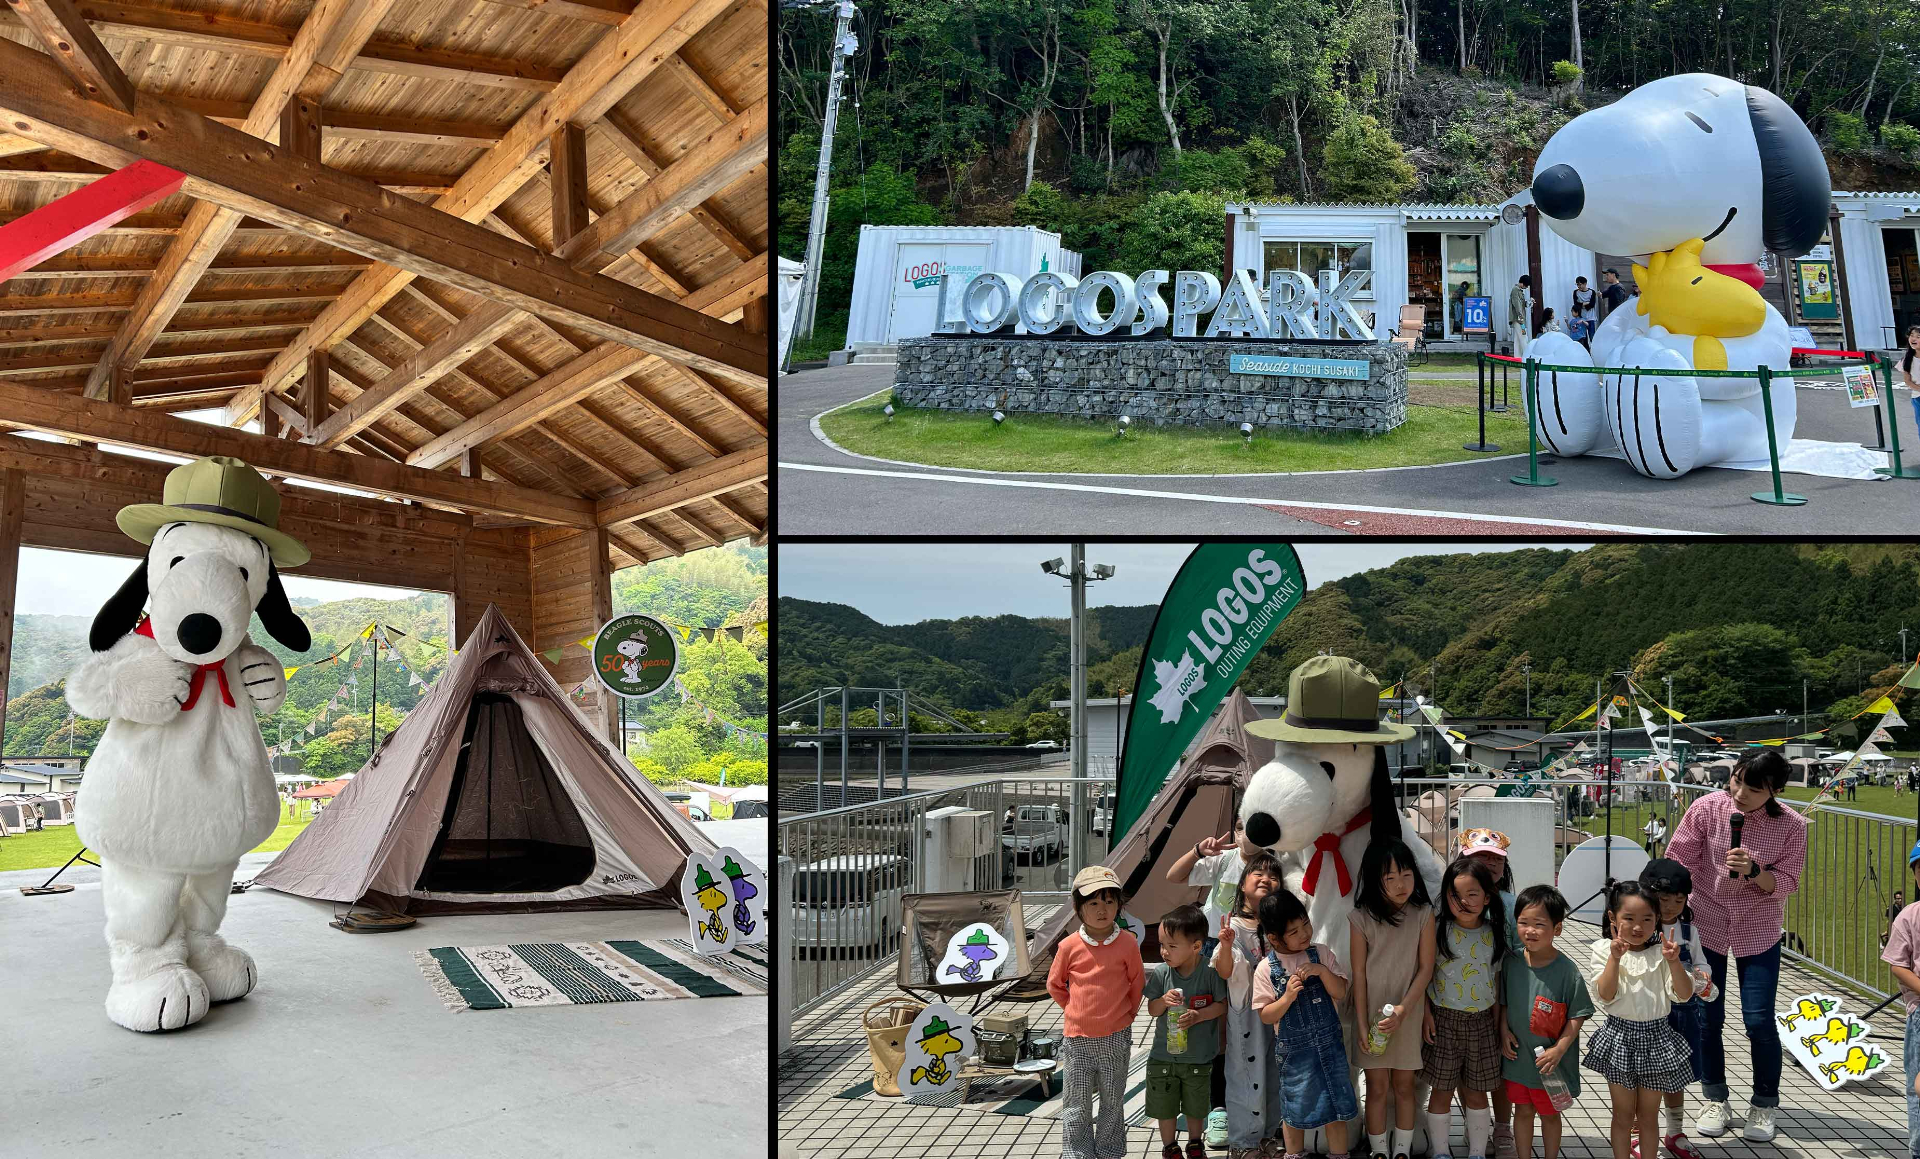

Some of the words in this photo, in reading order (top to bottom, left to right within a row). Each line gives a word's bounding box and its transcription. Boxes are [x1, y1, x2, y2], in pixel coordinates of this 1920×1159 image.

[904, 261, 946, 283] LOGOS
[1239, 357, 1290, 373] Seaside
[1292, 363, 1321, 375] KOCHI
[1323, 365, 1359, 377] SUSAKI
[1187, 548, 1282, 665] LOGOS
[604, 619, 632, 640] BEAGLE
[634, 619, 664, 637] SCOUTS
[1216, 636, 1251, 678] OUTING
[1245, 577, 1299, 640] EQUIPMENT
[601, 654, 624, 672] 50
[642, 659, 670, 670] years
[1176, 667, 1199, 697] LOGOS
